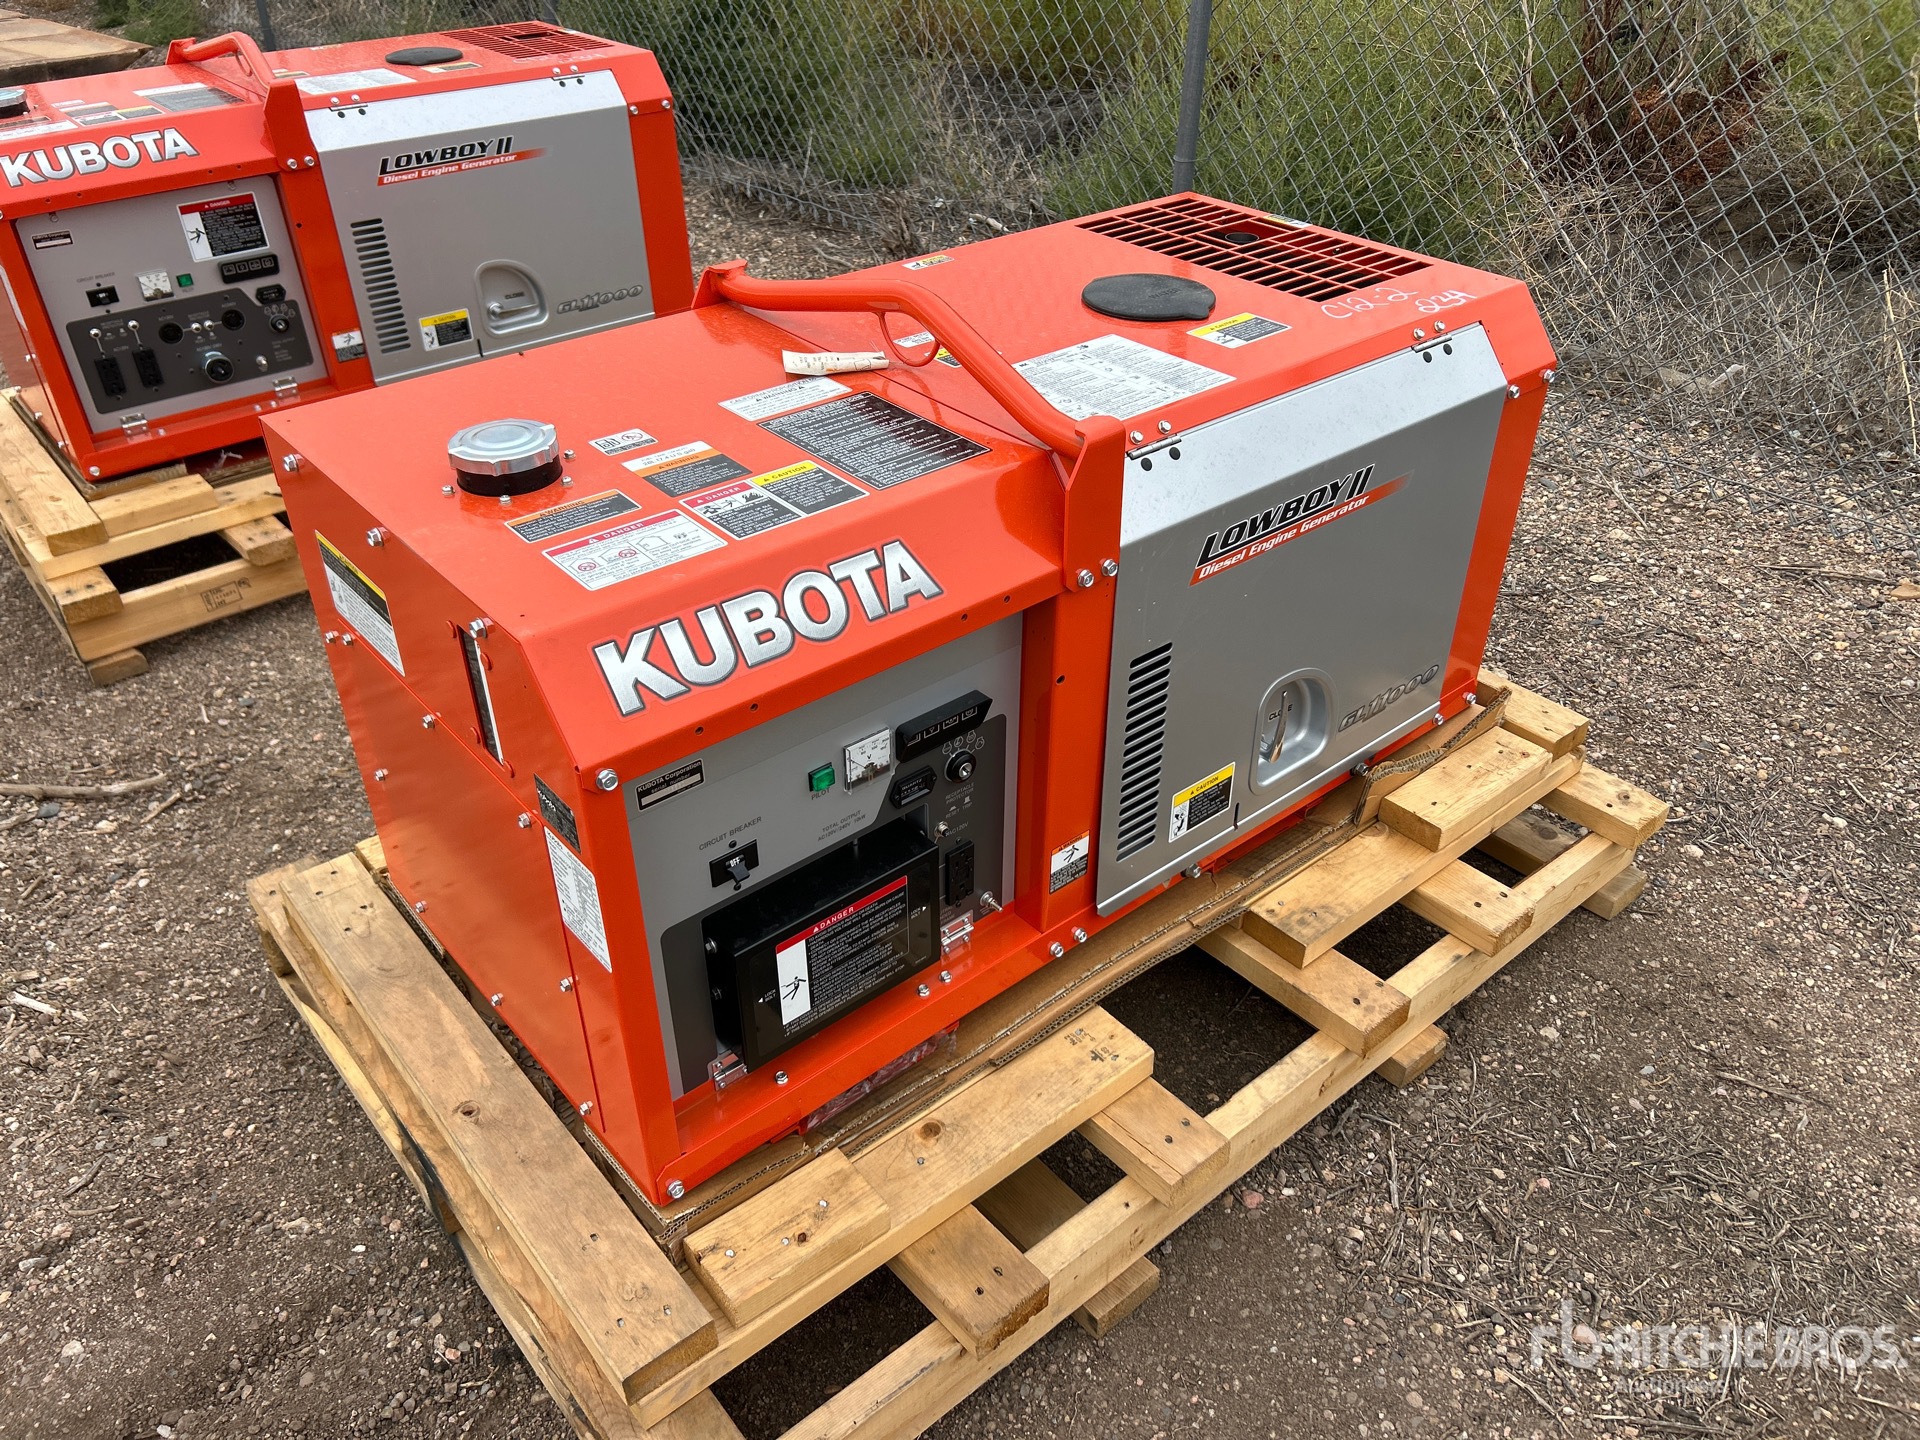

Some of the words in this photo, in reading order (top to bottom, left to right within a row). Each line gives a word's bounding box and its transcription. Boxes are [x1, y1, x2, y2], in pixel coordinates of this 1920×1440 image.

[0, 128, 199, 187] KUBOTA
[379, 139, 493, 175] LOWBOY
[495, 136, 513, 154] II
[384, 171, 418, 184] Diesel
[421, 164, 458, 178] Engine
[462, 153, 517, 169] Generator
[557, 285, 643, 314] GL11000
[772, 465, 807, 480] CAUTION
[705, 487, 740, 500] DANGER
[545, 500, 585, 516] WARNING
[1195, 473, 1352, 569] LOWBOY
[1345, 463, 1375, 502] II
[603, 522, 644, 540] DANGER
[1199, 551, 1246, 579] Diesel
[1248, 527, 1297, 557] Engine
[1299, 495, 1370, 533] Generator
[593, 539, 944, 717] KUBOTA
[1338, 664, 1440, 732] GL11000
[1269, 703, 1293, 721] CLOE
[638, 778, 665, 792] KUBOTA
[665, 761, 702, 780] Corporation
[1196, 776, 1219, 792] CAUTION
[811, 788, 830, 800] PILOT
[945, 782, 974, 800] RECEPTACLE
[946, 788, 974, 804] PROTECTOR
[822, 822, 840, 833] TOTAL
[840, 810, 862, 825] OUTPUT
[946, 808, 960, 819] RESET
[698, 832, 727, 851] CIRCUIT
[729, 816, 762, 837] BREAKER
[729, 857, 741, 867] OFF
[819, 905, 853, 929] DANGER
[910, 907, 921, 916] LOCK
[911, 912, 922, 920] BOLT
[764, 989, 776, 998] LOCK
[765, 993, 777, 1002] BOLT
